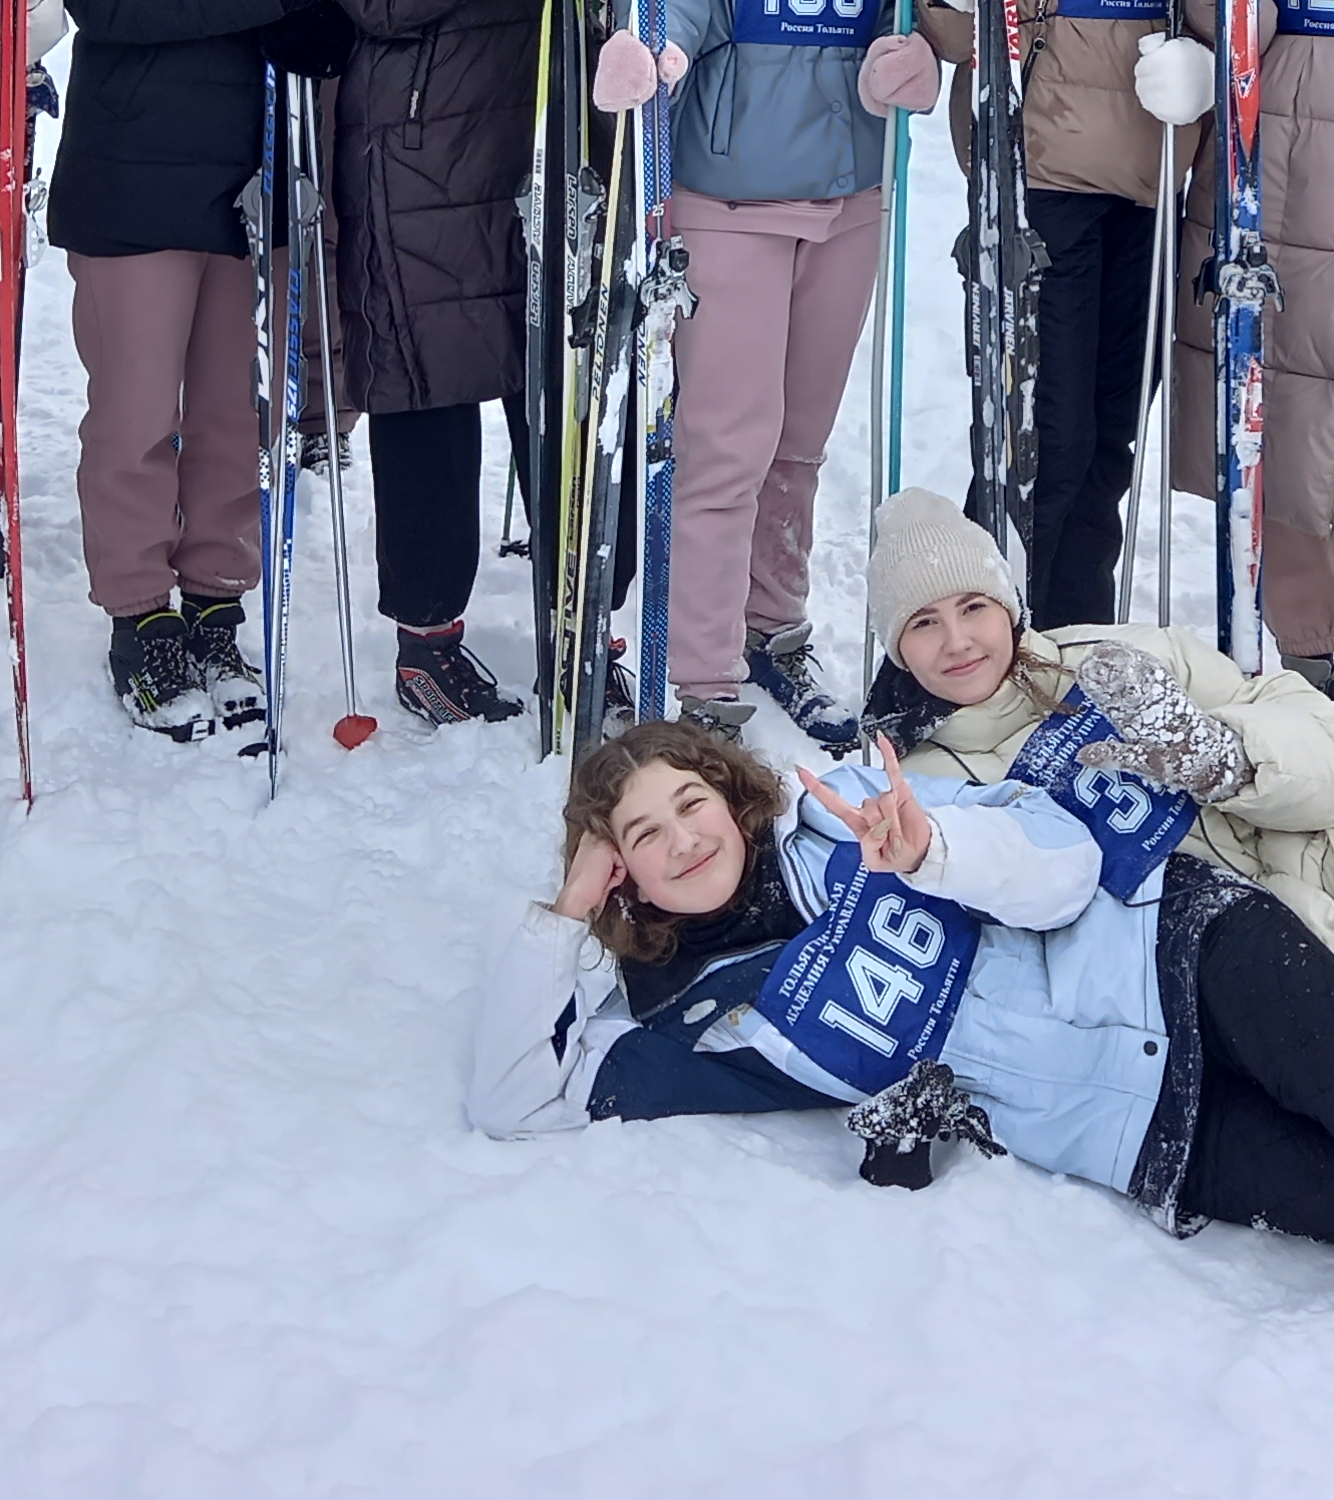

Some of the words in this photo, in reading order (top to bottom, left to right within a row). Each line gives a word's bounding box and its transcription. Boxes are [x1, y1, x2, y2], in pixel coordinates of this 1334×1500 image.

[781, 22, 814, 33] Россия
[567, 173, 578, 240] Larsen
[287, 267, 301, 378] CLASSIC
[530, 260, 542, 328] Larsen
[591, 282, 611, 401] PELTONEN
[1141, 813, 1176, 852] Россия
[819, 893, 946, 1059] 146
[907, 1017, 937, 1061] Россия
[929, 957, 962, 1017] Тольятти
